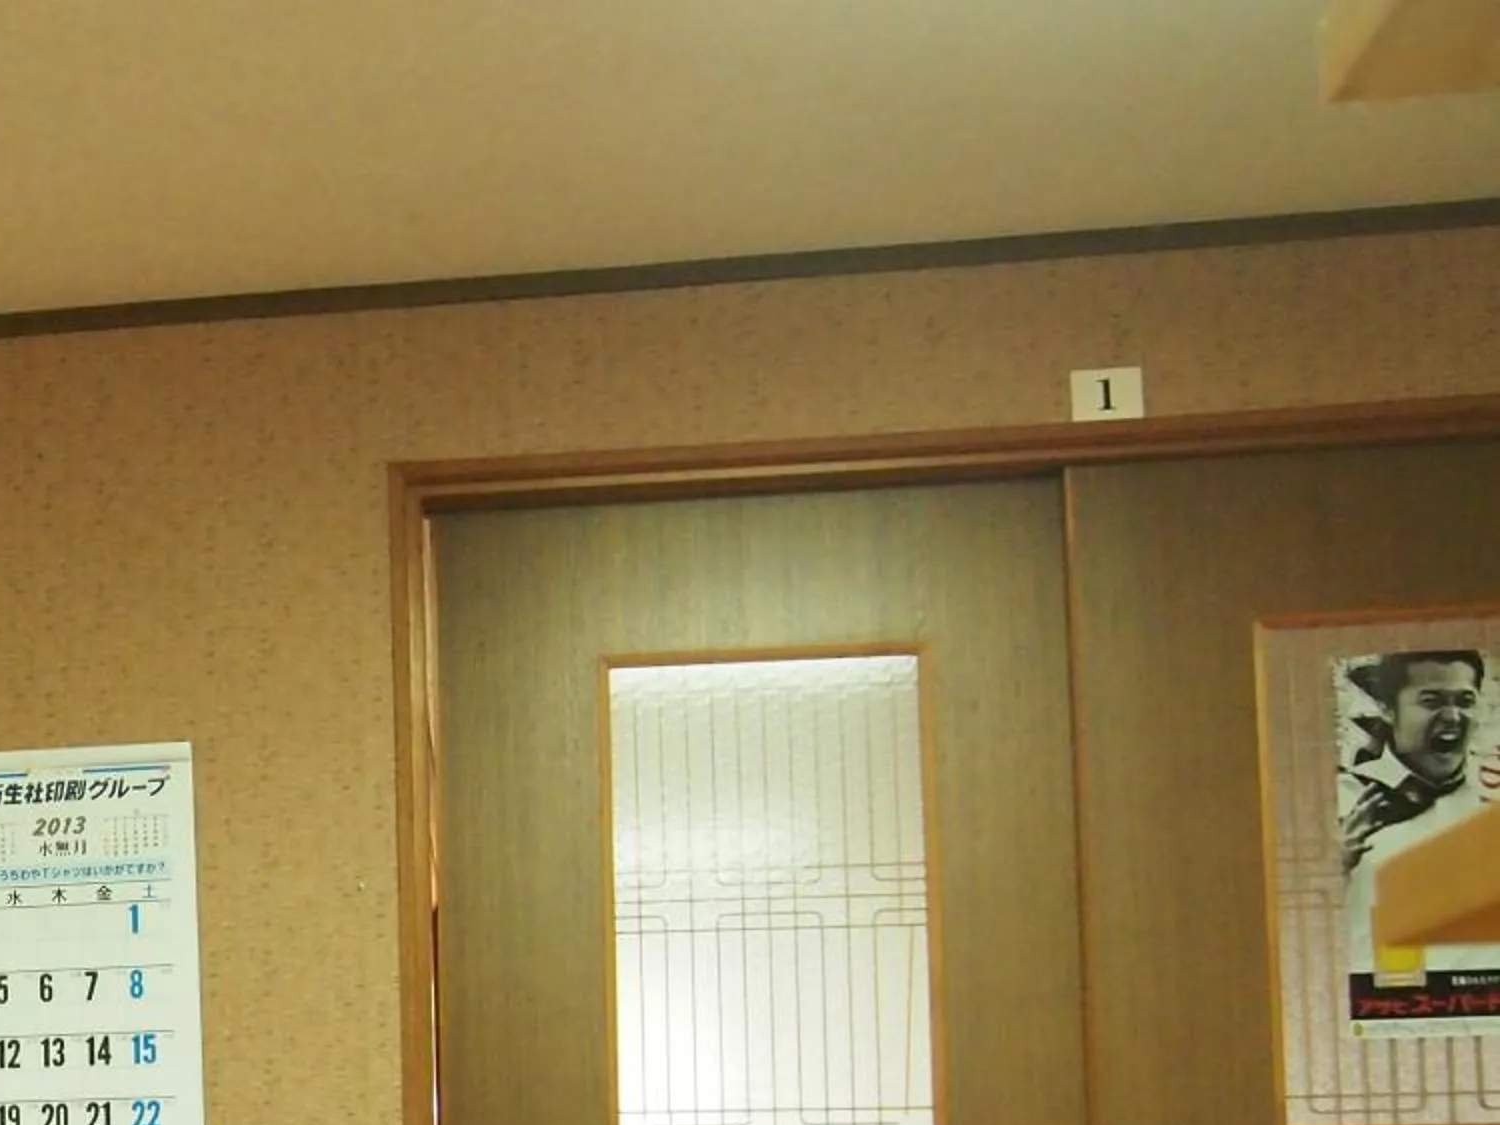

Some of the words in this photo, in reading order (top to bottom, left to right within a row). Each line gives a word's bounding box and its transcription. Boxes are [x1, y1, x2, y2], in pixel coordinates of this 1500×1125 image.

[1095, 378, 1117, 411] 1
[32, 816, 87, 837] 2013
[39, 839, 87, 857] 水無月
[6, 889, 23, 905] 水
[51, 887, 67, 903] 木
[96, 885, 113, 901] 金
[128, 904, 139, 934] 1
[40, 973, 52, 1002] 6
[84, 971, 98, 1001] 7
[130, 970, 143, 998] 8
[41, 1038, 65, 1068] 13
[86, 1035, 111, 1066] 14
[131, 1034, 157, 1064] 15
